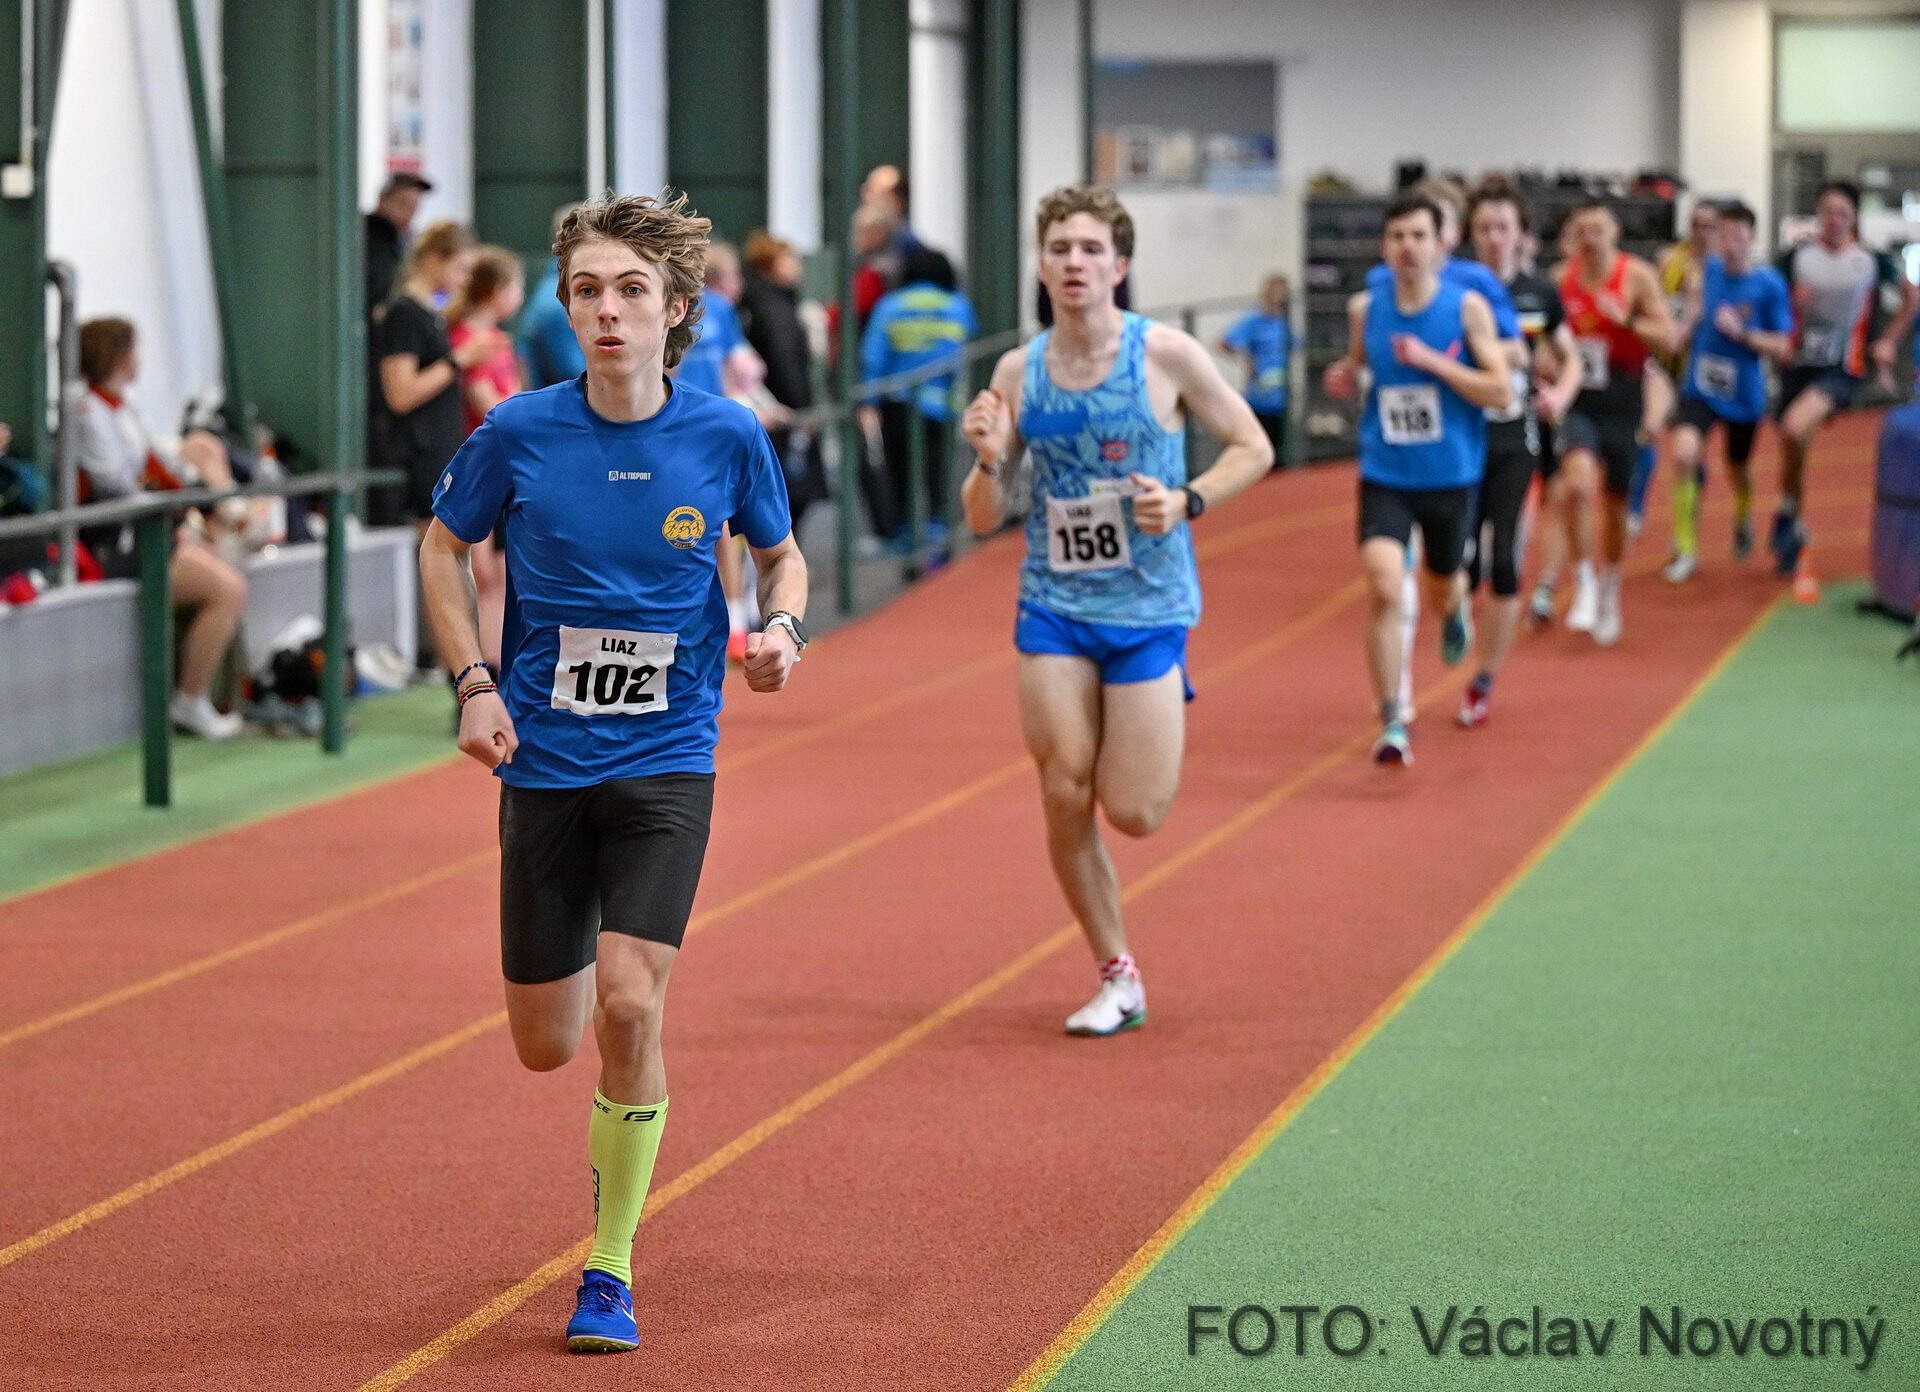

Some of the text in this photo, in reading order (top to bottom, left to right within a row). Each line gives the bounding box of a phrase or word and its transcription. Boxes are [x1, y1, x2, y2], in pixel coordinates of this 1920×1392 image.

[1056, 523, 1119, 562] 158
[601, 637, 637, 655] LIAZ
[568, 661, 659, 705] 102
